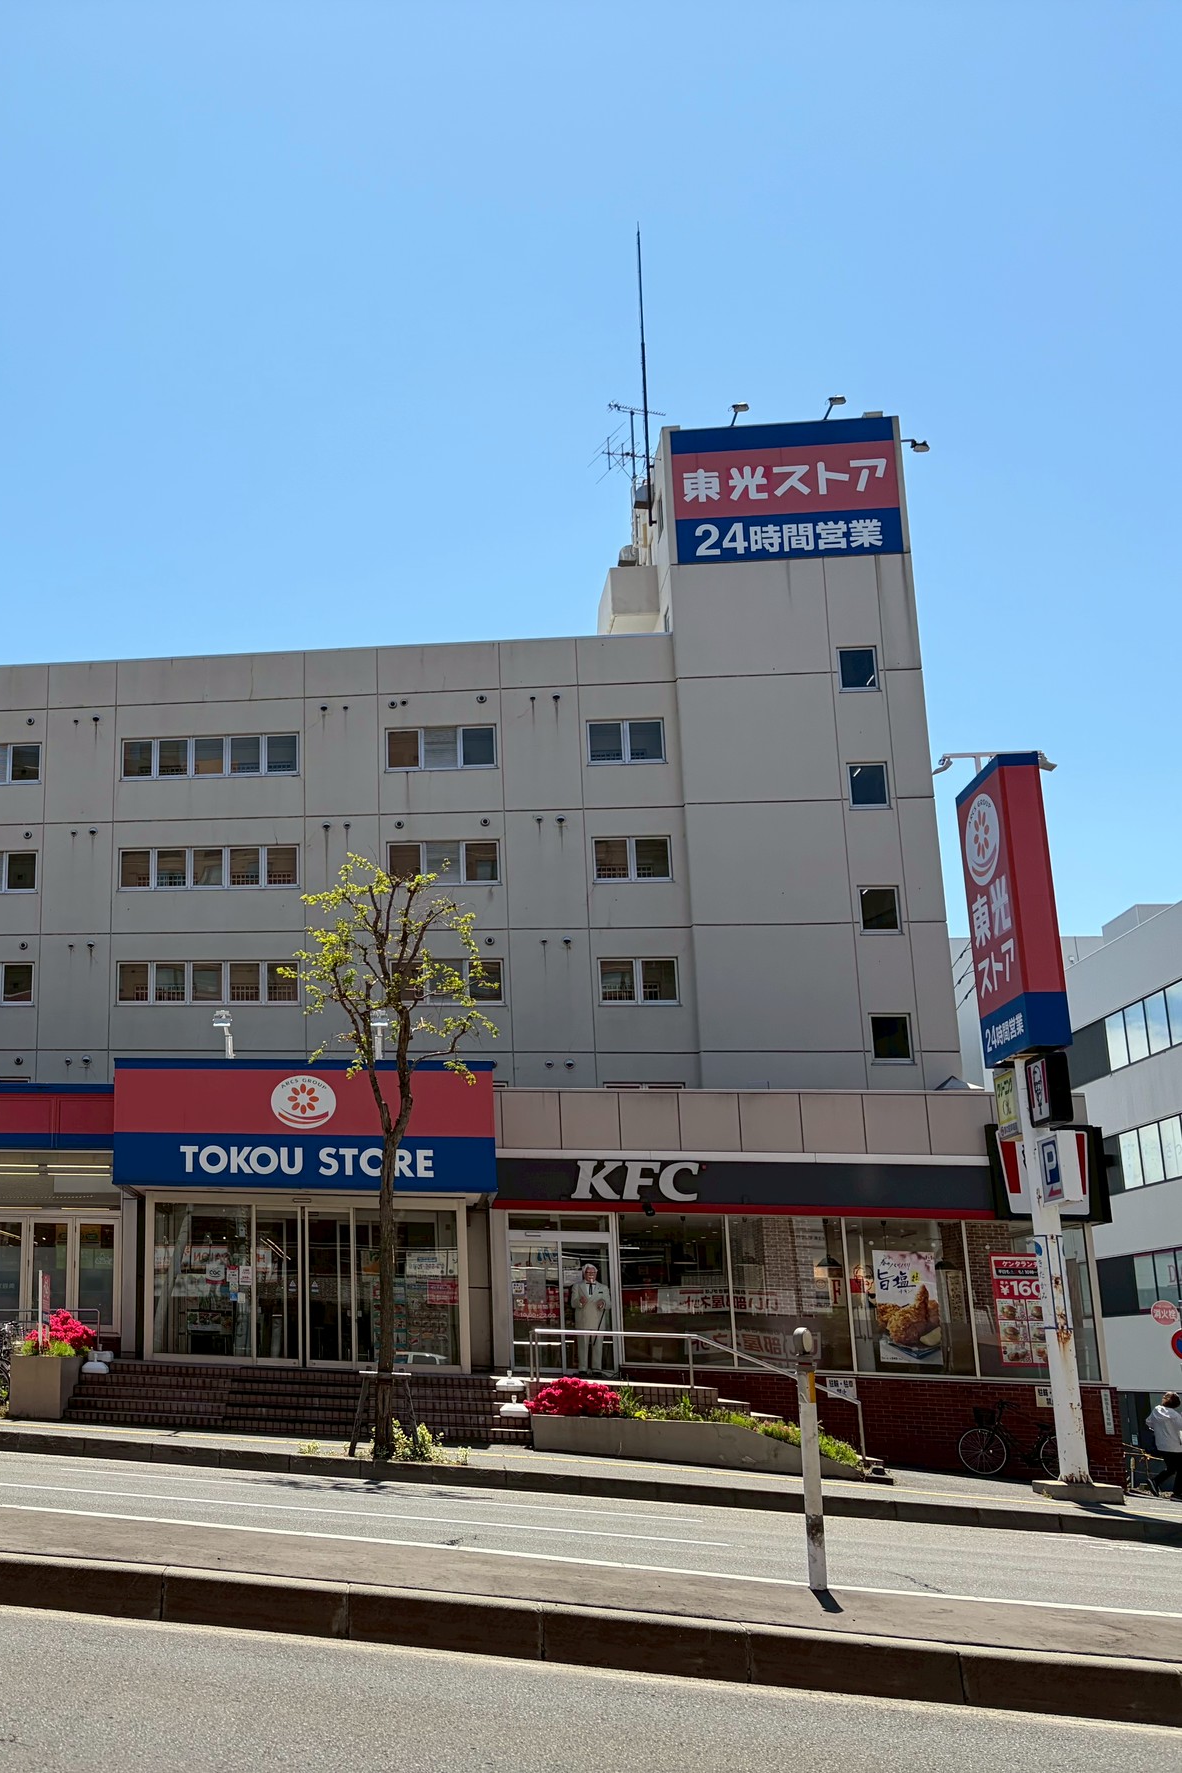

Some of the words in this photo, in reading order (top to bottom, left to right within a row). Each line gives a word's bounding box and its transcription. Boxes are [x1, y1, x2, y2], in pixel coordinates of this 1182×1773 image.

[682, 458, 887, 503] 東光ストア
[694, 518, 883, 557] 24時間営業
[972, 873, 1013, 947] 東光
[977, 938, 1015, 999] ストア
[985, 1013, 1025, 1053] 24時間営業
[281, 1078, 299, 1089] ARCS
[302, 1078, 327, 1090] GROUP
[179, 1145, 303, 1175] TOKOU
[318, 1147, 435, 1178] STORE
[570, 1160, 700, 1202] KFC
[1043, 1143, 1057, 1183] P
[877, 1269, 916, 1291] 旨塩
